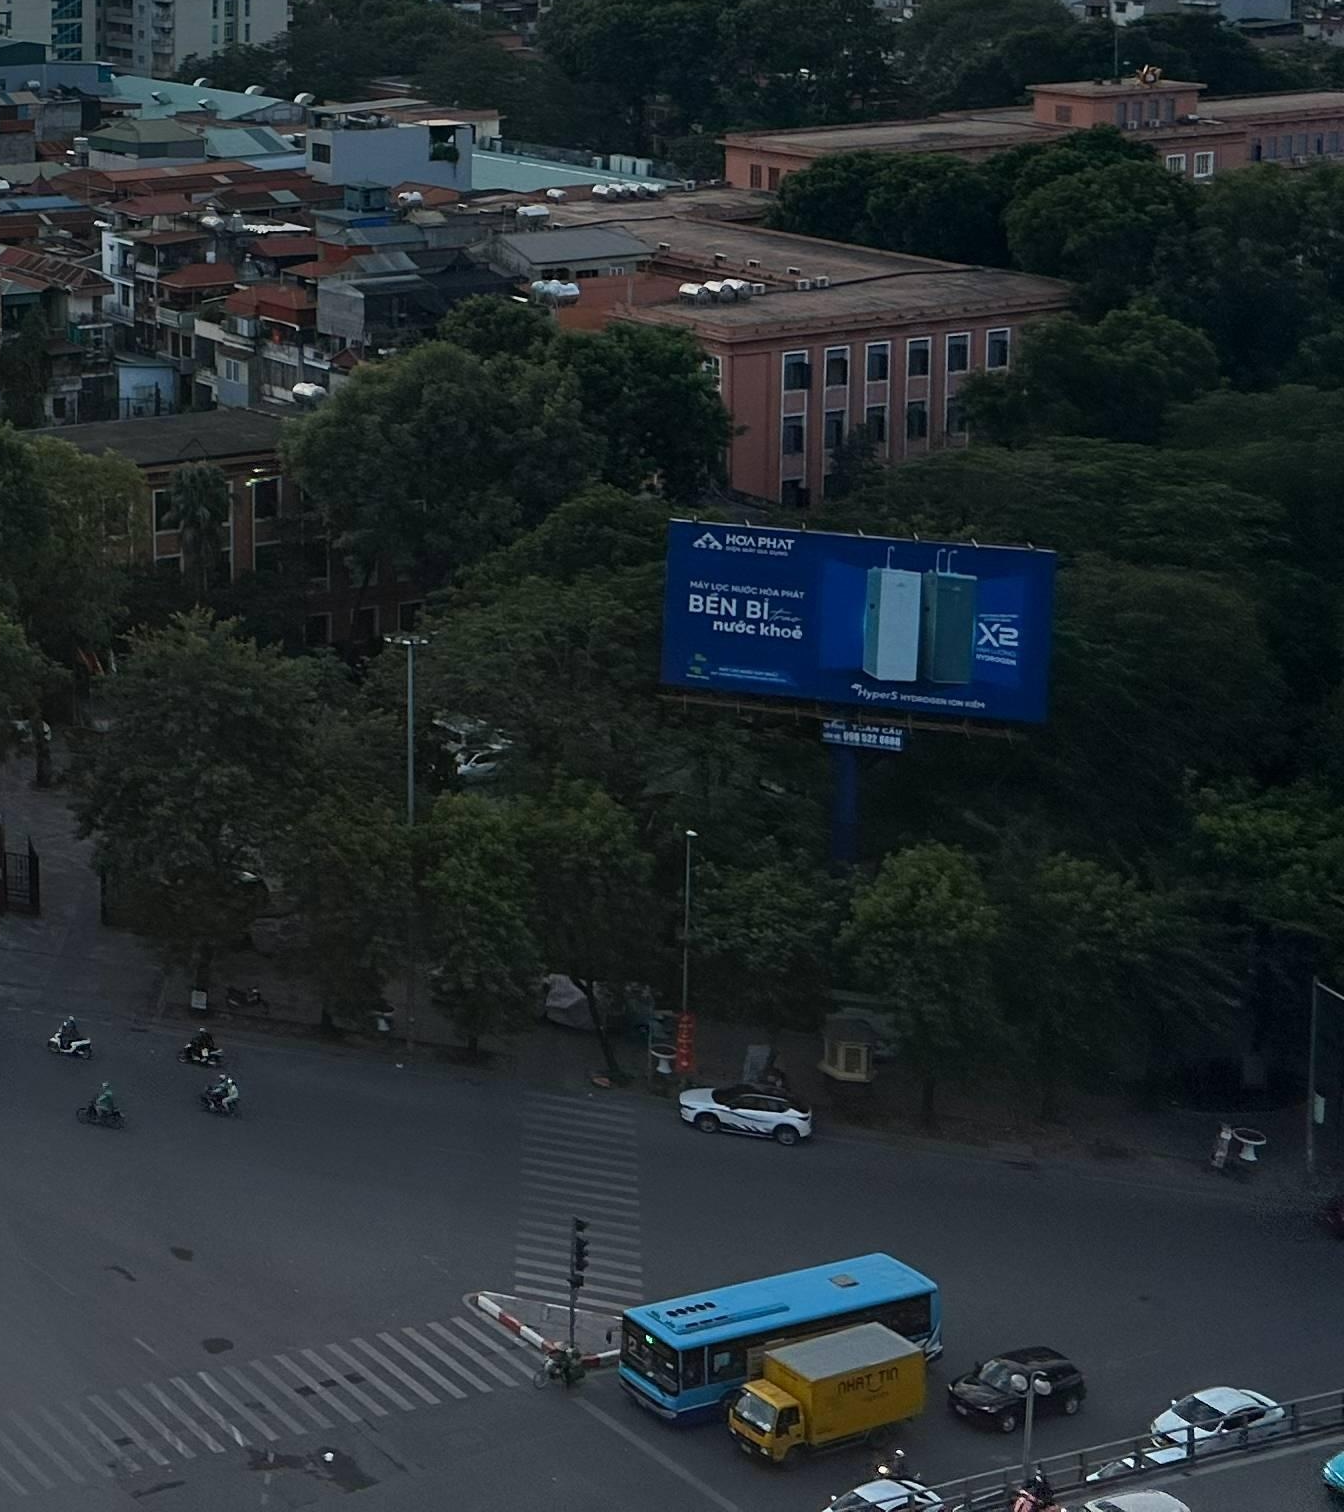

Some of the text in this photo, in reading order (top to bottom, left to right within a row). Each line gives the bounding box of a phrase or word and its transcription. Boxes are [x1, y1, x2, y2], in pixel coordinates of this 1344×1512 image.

[713, 620, 756, 635] nước
[977, 622, 1019, 647] X2
[857, 688, 898, 702] HyperS
